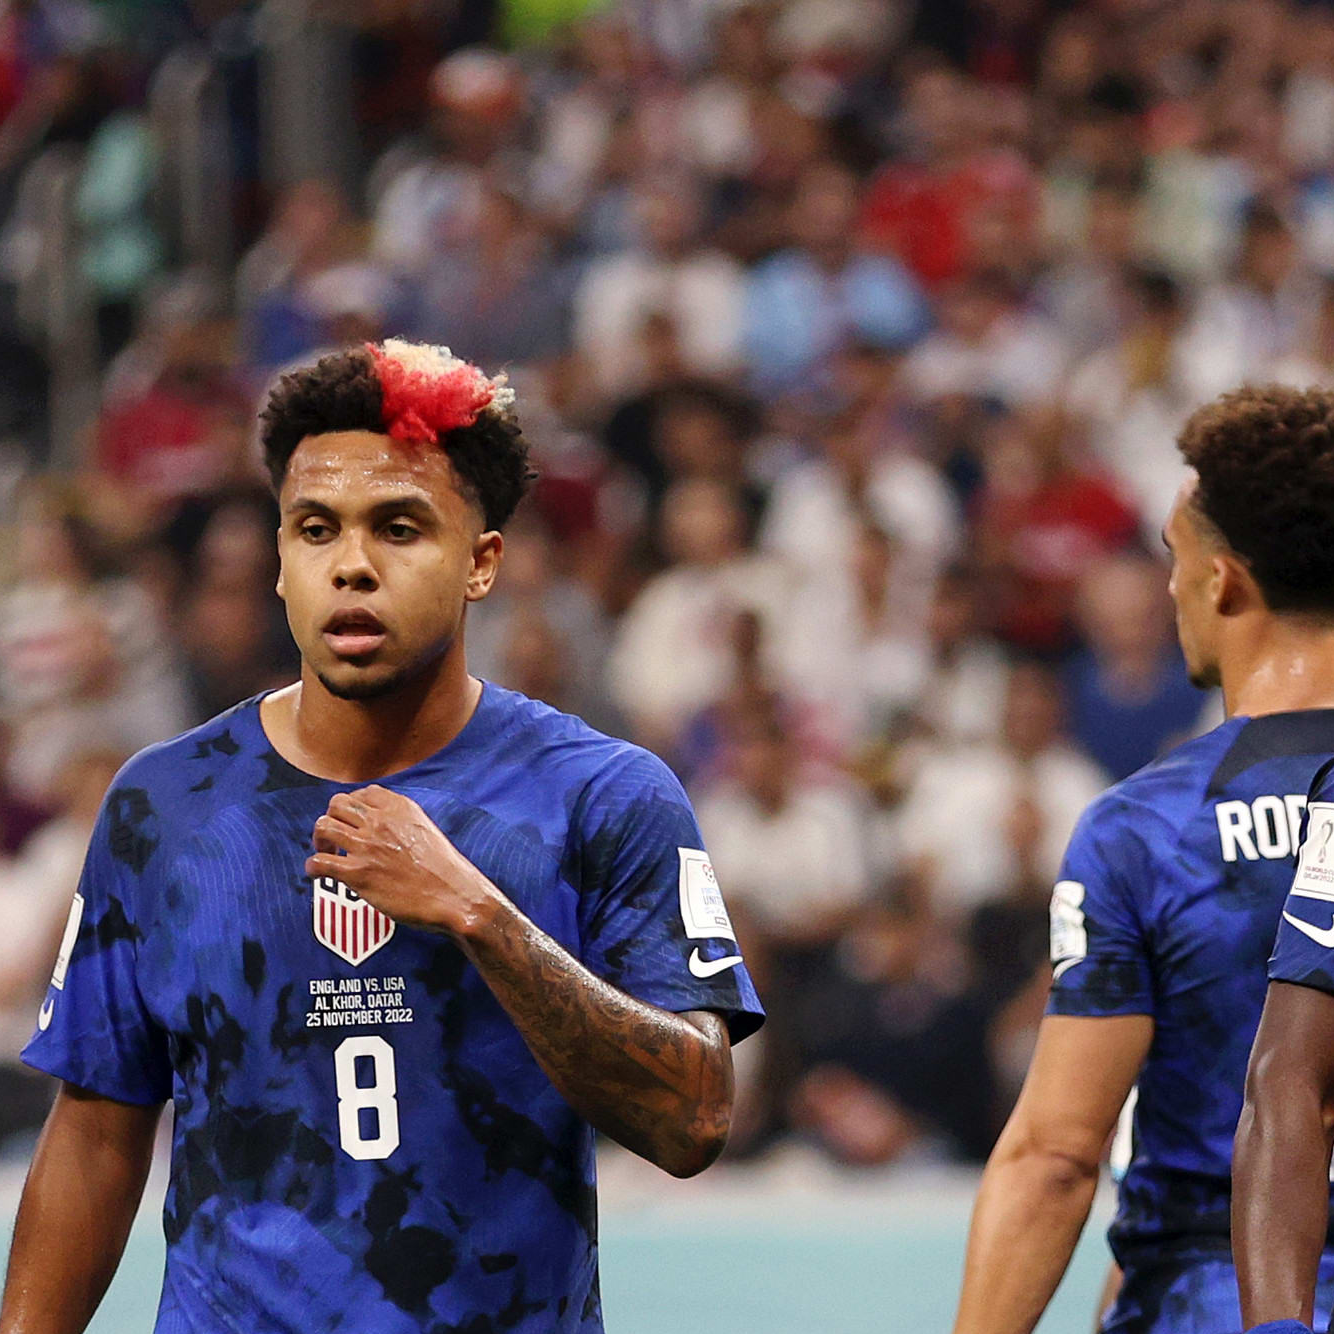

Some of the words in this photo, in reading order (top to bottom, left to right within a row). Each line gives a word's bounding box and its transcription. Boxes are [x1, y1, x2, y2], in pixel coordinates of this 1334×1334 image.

[309, 978, 361, 995] ENGLAND
[363, 977, 381, 992] VS.
[383, 977, 405, 991] USA
[315, 996, 330, 1010] AL
[332, 995, 366, 1010] KHOR,
[367, 993, 403, 1008] QATAR
[306, 1012, 321, 1027] 25
[323, 1010, 382, 1026] NOVEMBER
[384, 1008, 413, 1023] 2022
[334, 1035, 400, 1161] 8
